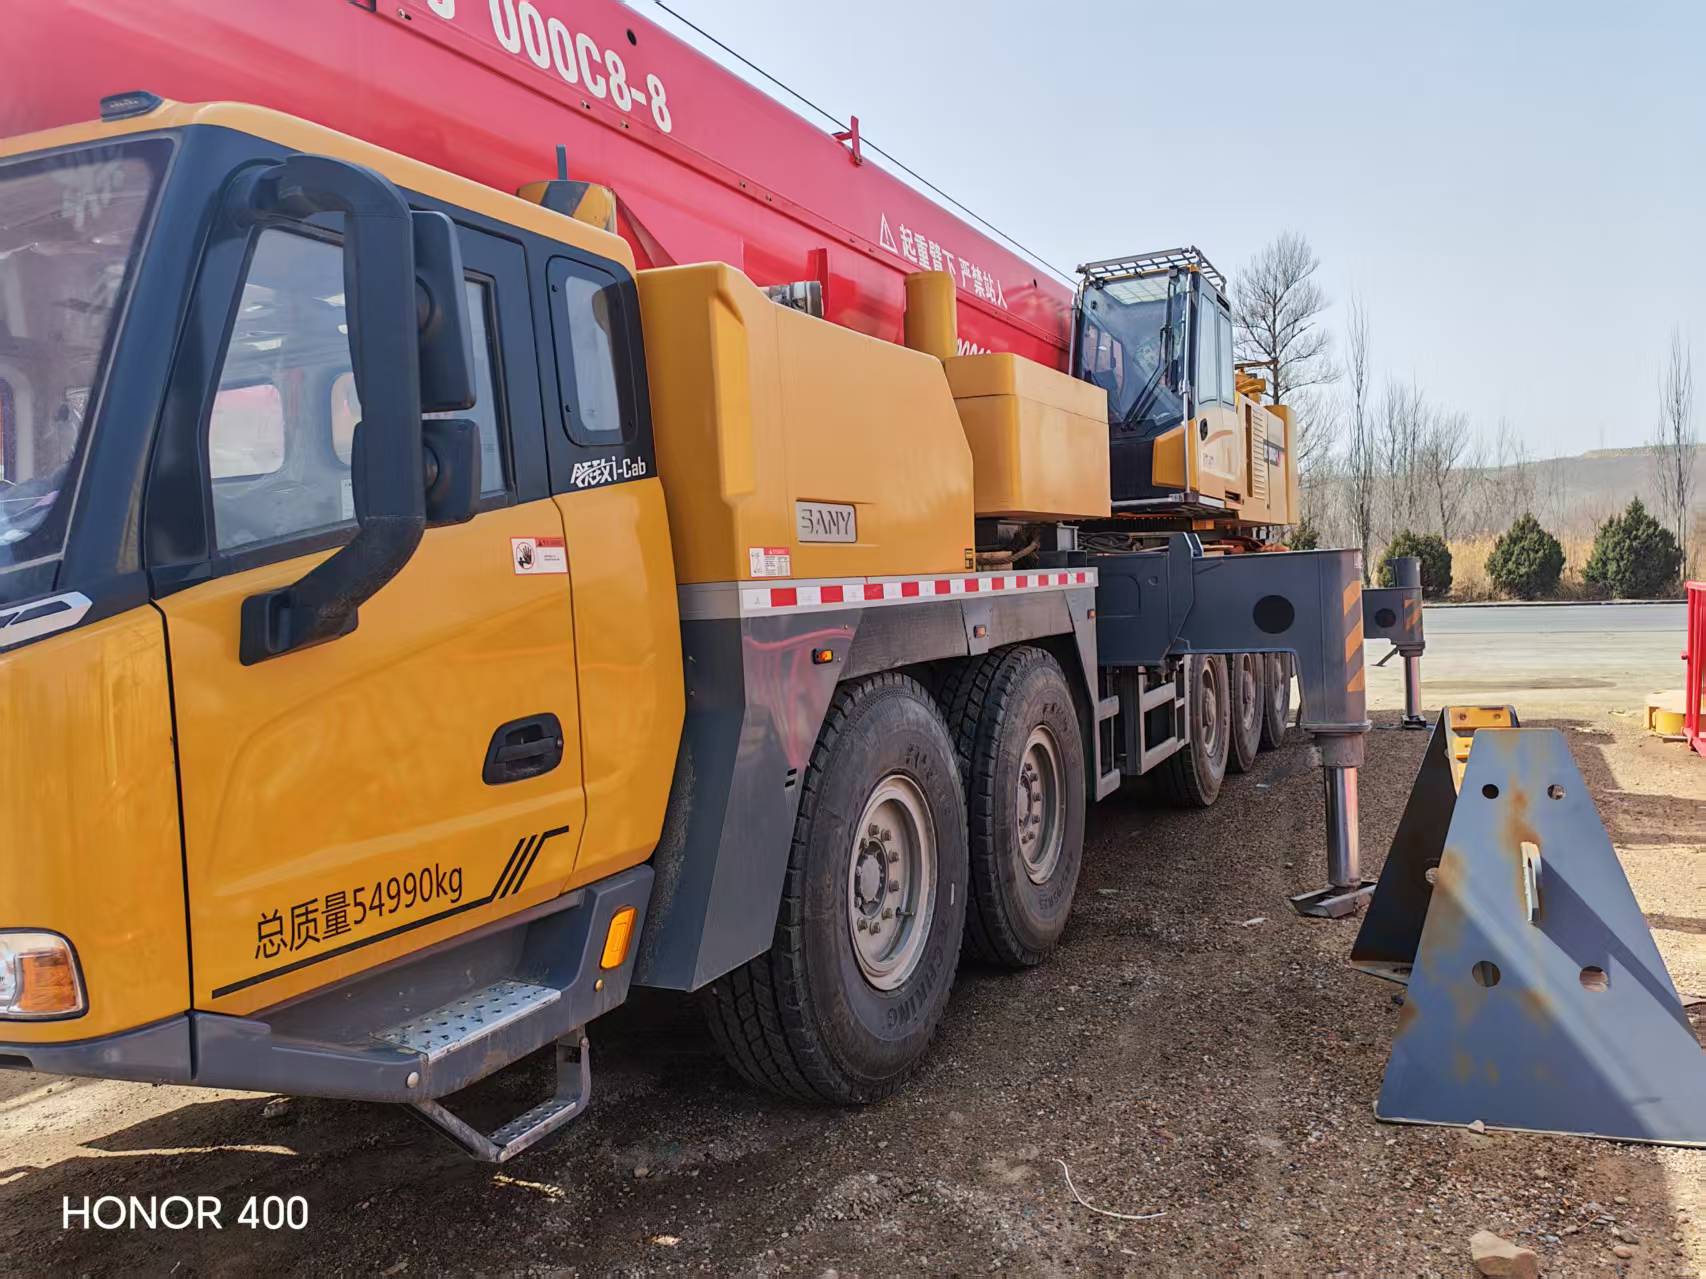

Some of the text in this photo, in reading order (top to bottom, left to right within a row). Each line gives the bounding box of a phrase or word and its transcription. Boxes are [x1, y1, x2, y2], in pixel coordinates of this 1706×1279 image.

[958, 256, 1008, 310] 严禁站人
[800, 509, 852, 535] SANY
[255, 862, 463, 960] 总质量54990kg
